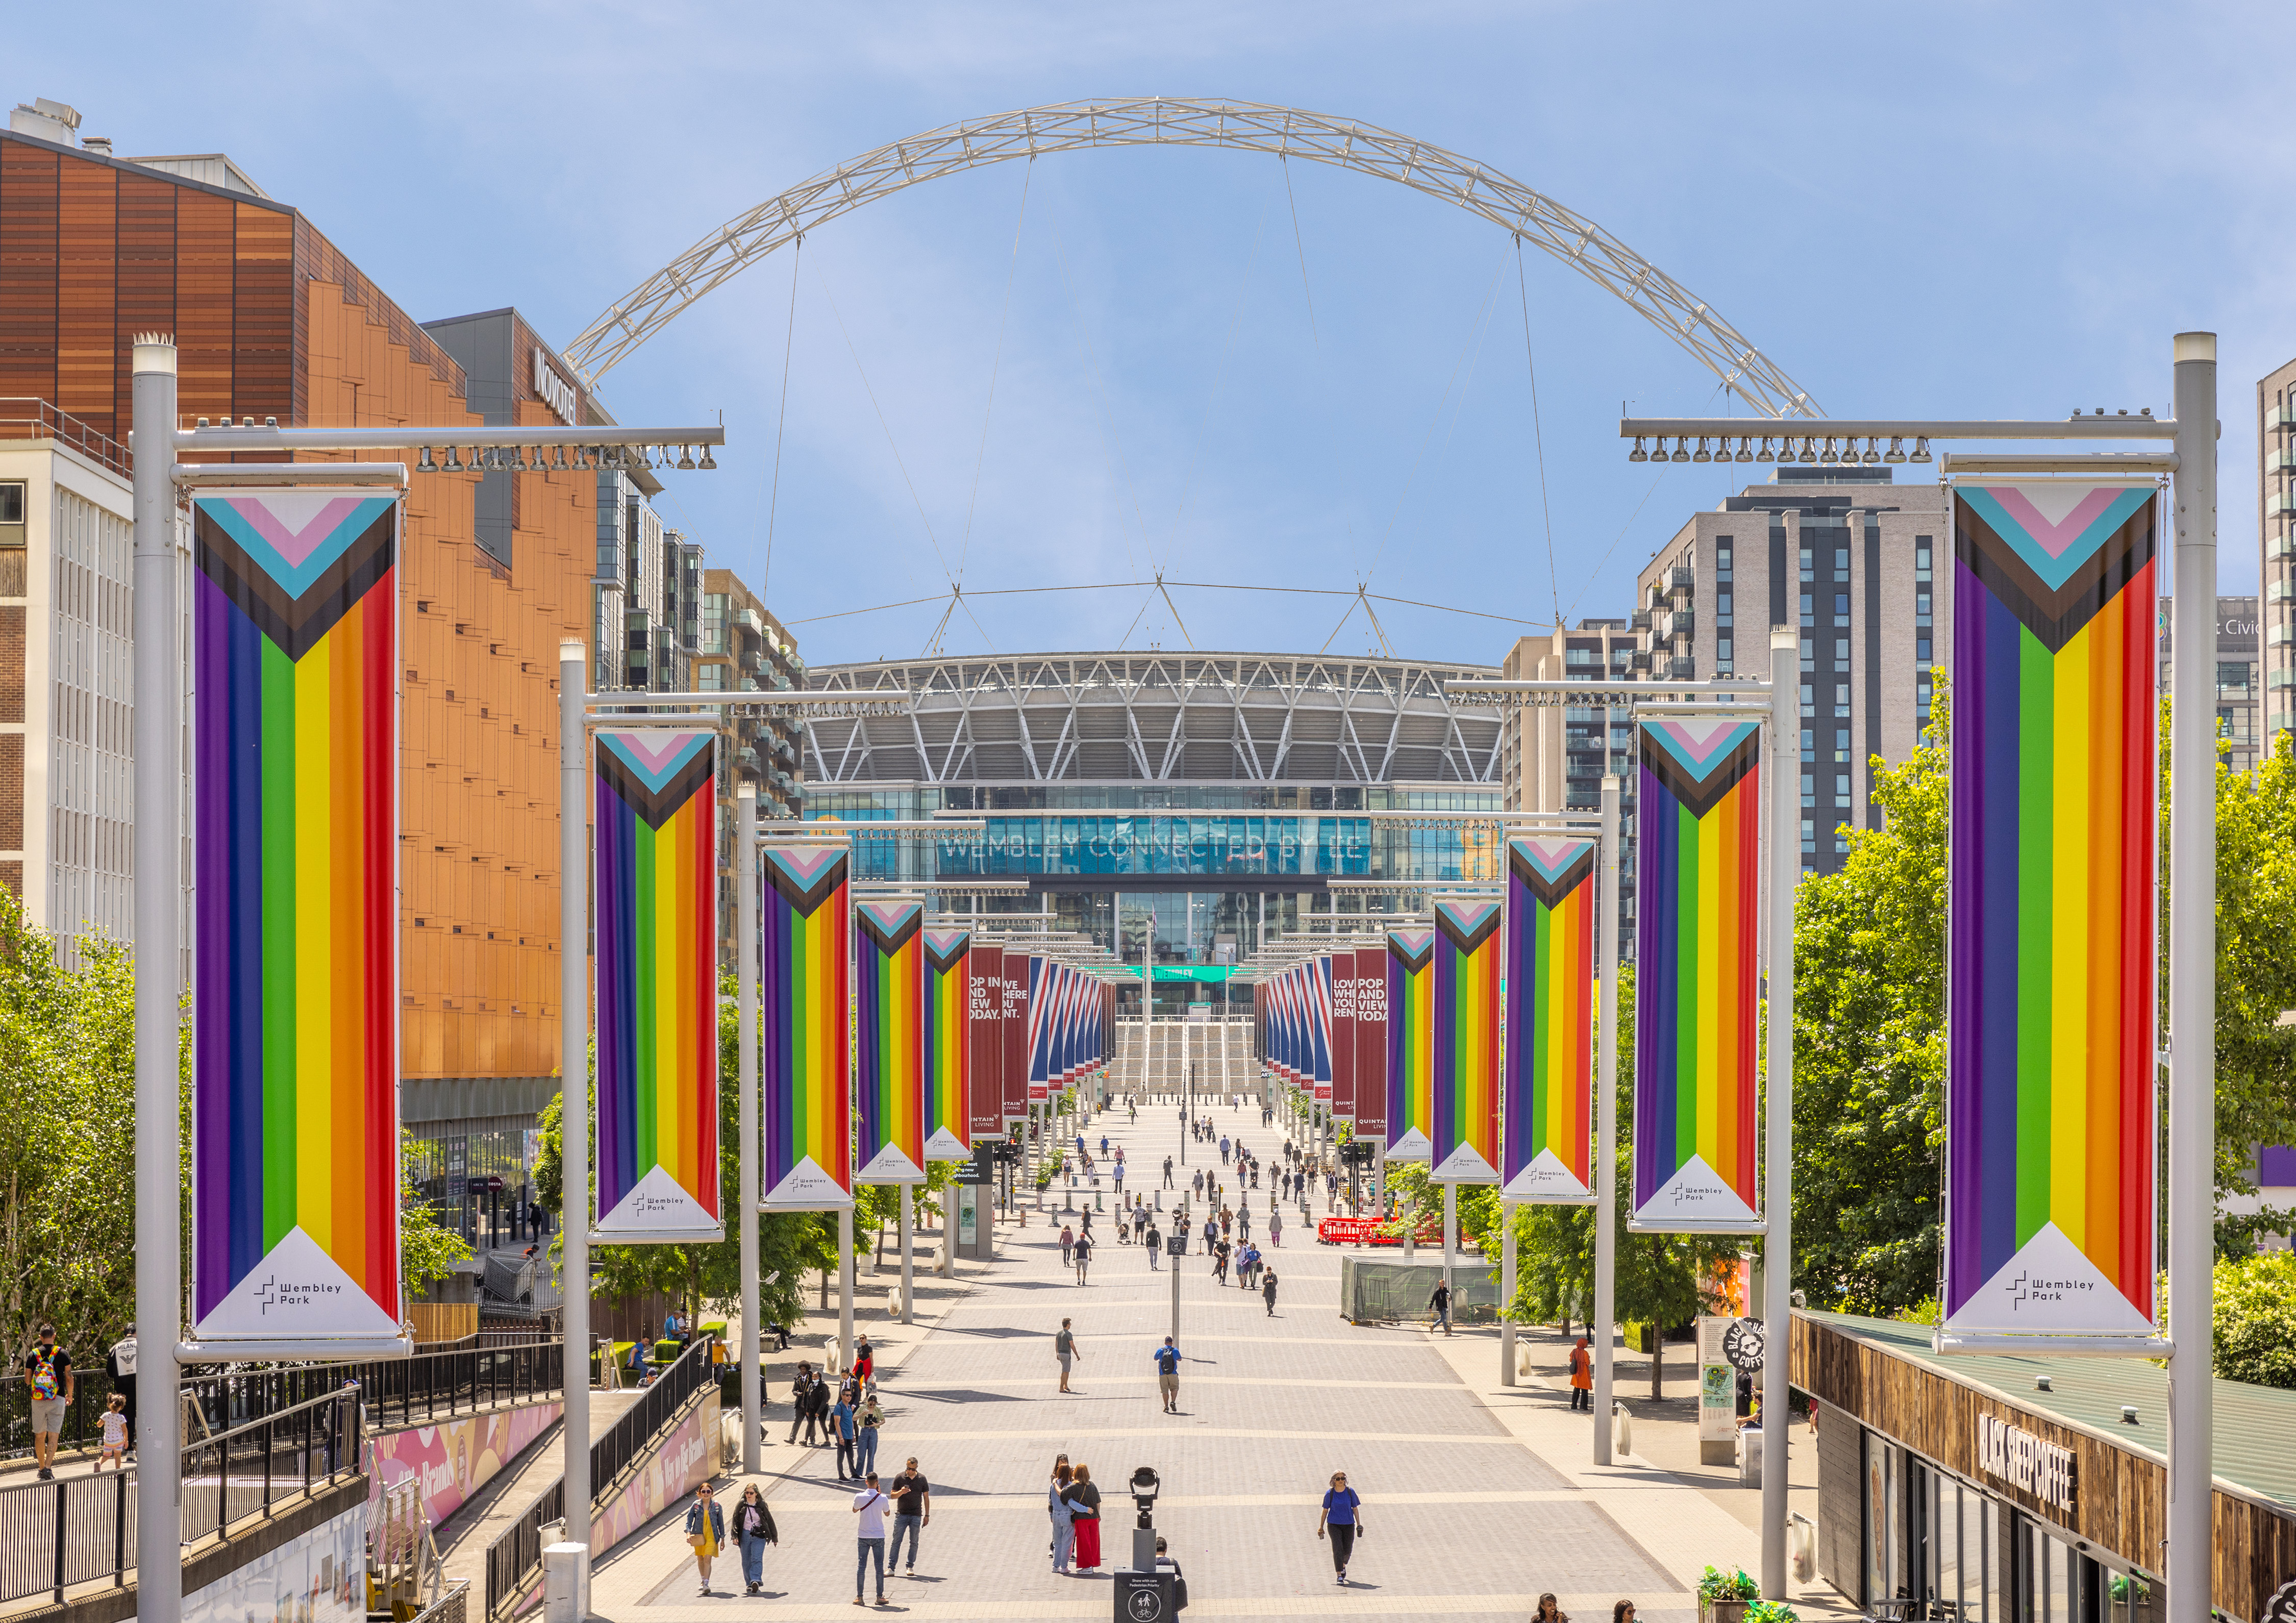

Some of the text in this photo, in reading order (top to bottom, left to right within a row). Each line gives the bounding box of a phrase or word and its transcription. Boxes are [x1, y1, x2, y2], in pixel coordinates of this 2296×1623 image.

[944, 834, 1362, 858] WEMBLEY CONNECTED BY EE
[1155, 969, 1193, 979] WEMBLEY
[970, 977, 1001, 987] OP IN
[1334, 979, 1354, 989] LOV
[1358, 978, 1384, 989] POP
[970, 988, 986, 998] ND
[1003, 990, 1027, 999] HERE
[1357, 989, 1385, 999] AND
[1334, 998, 1355, 1008] YOU
[1357, 1000, 1387, 1011] VIEW
[970, 1009, 1001, 1020] ODAY.
[1004, 1009, 1020, 1018] NT.
[1334, 1008, 1354, 1017] REN
[1357, 1011, 1387, 1021] TODA
[280, 1284, 341, 1294] Wembley
[2033, 1280, 2094, 1291] Wembley
[280, 1295, 310, 1304] Park
[2033, 1292, 2062, 1300] Park
[1728, 1327, 1744, 1349] BLAC
[664, 1456, 675, 1492] Way
[675, 1454, 681, 1480] to
[680, 1441, 688, 1480] Big
[688, 1428, 707, 1467] Brands
[1979, 1413, 2073, 1513] BLACK SHEEP COFFEE
[422, 1448, 454, 1502] Brands
